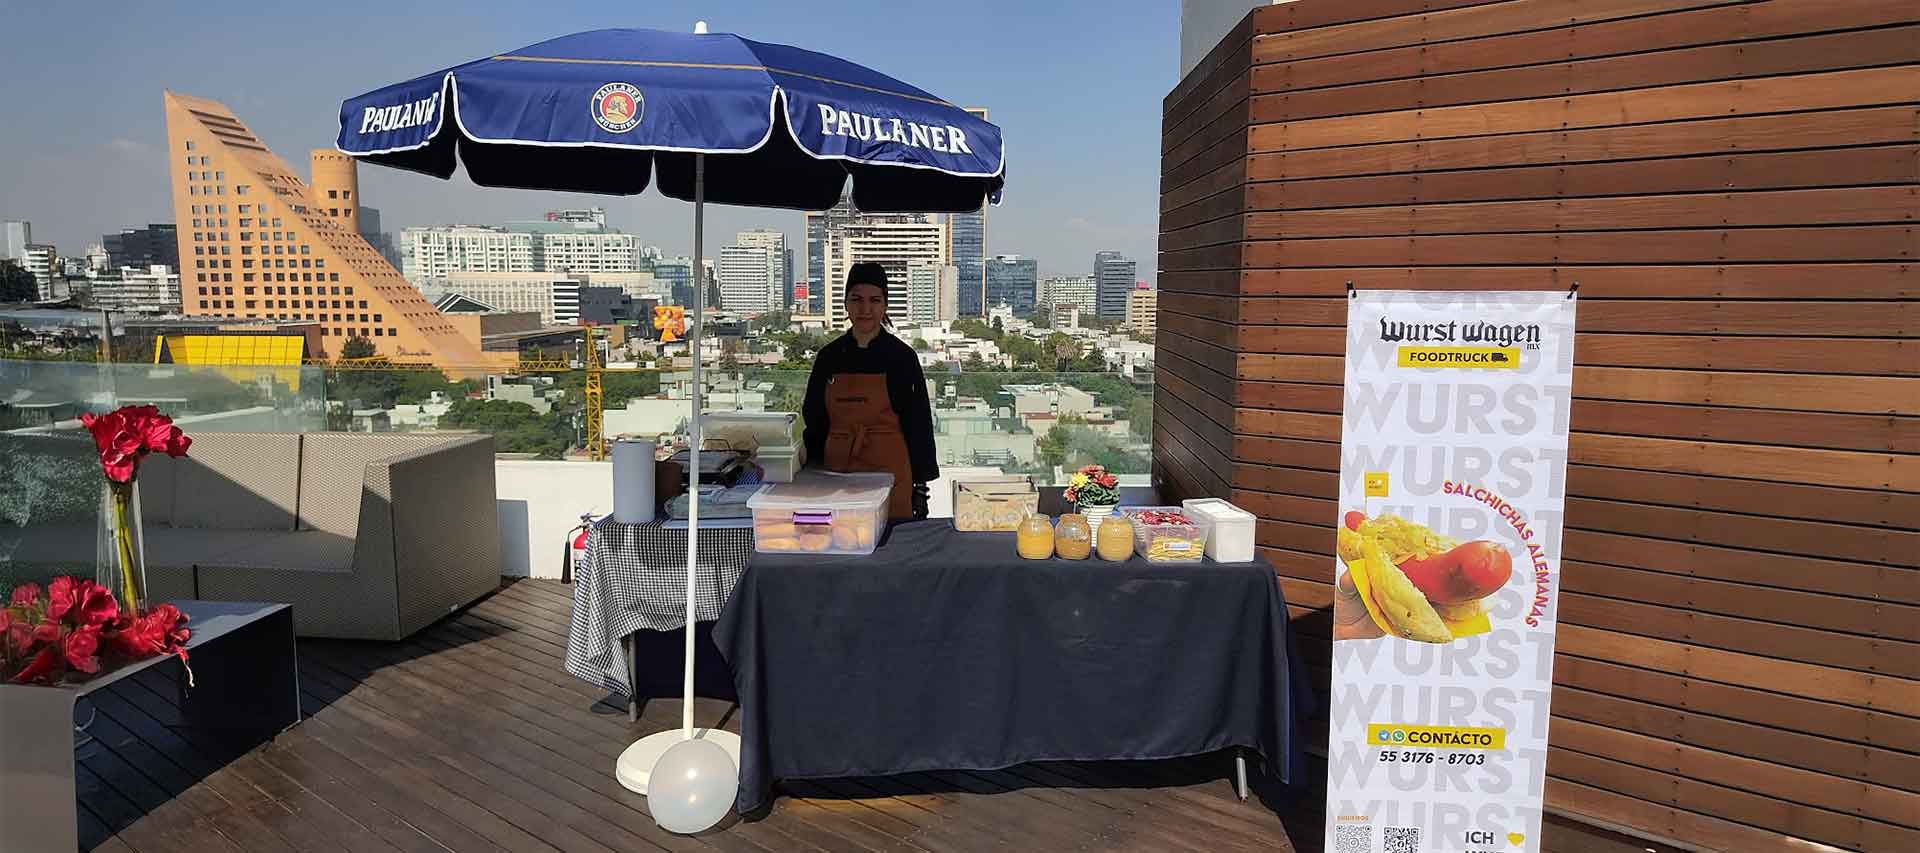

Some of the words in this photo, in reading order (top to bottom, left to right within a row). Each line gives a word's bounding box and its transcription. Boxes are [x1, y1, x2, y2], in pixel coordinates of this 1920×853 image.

[359, 91, 440, 134] PAULAN
[817, 103, 973, 155] PAULANER
[1379, 316, 1457, 343] Wurst
[1461, 320, 1541, 348] wagen
[1409, 351, 1489, 363] FOODTRUCK
[1442, 480, 1534, 541] SALCHICHAS
[1525, 543, 1550, 628] ALEMANAS
[1379, 750, 1398, 763] 55
[1401, 751, 1434, 764] 3176
[1447, 753, 1485, 766] 8703
[1465, 831, 1495, 845] ICH
